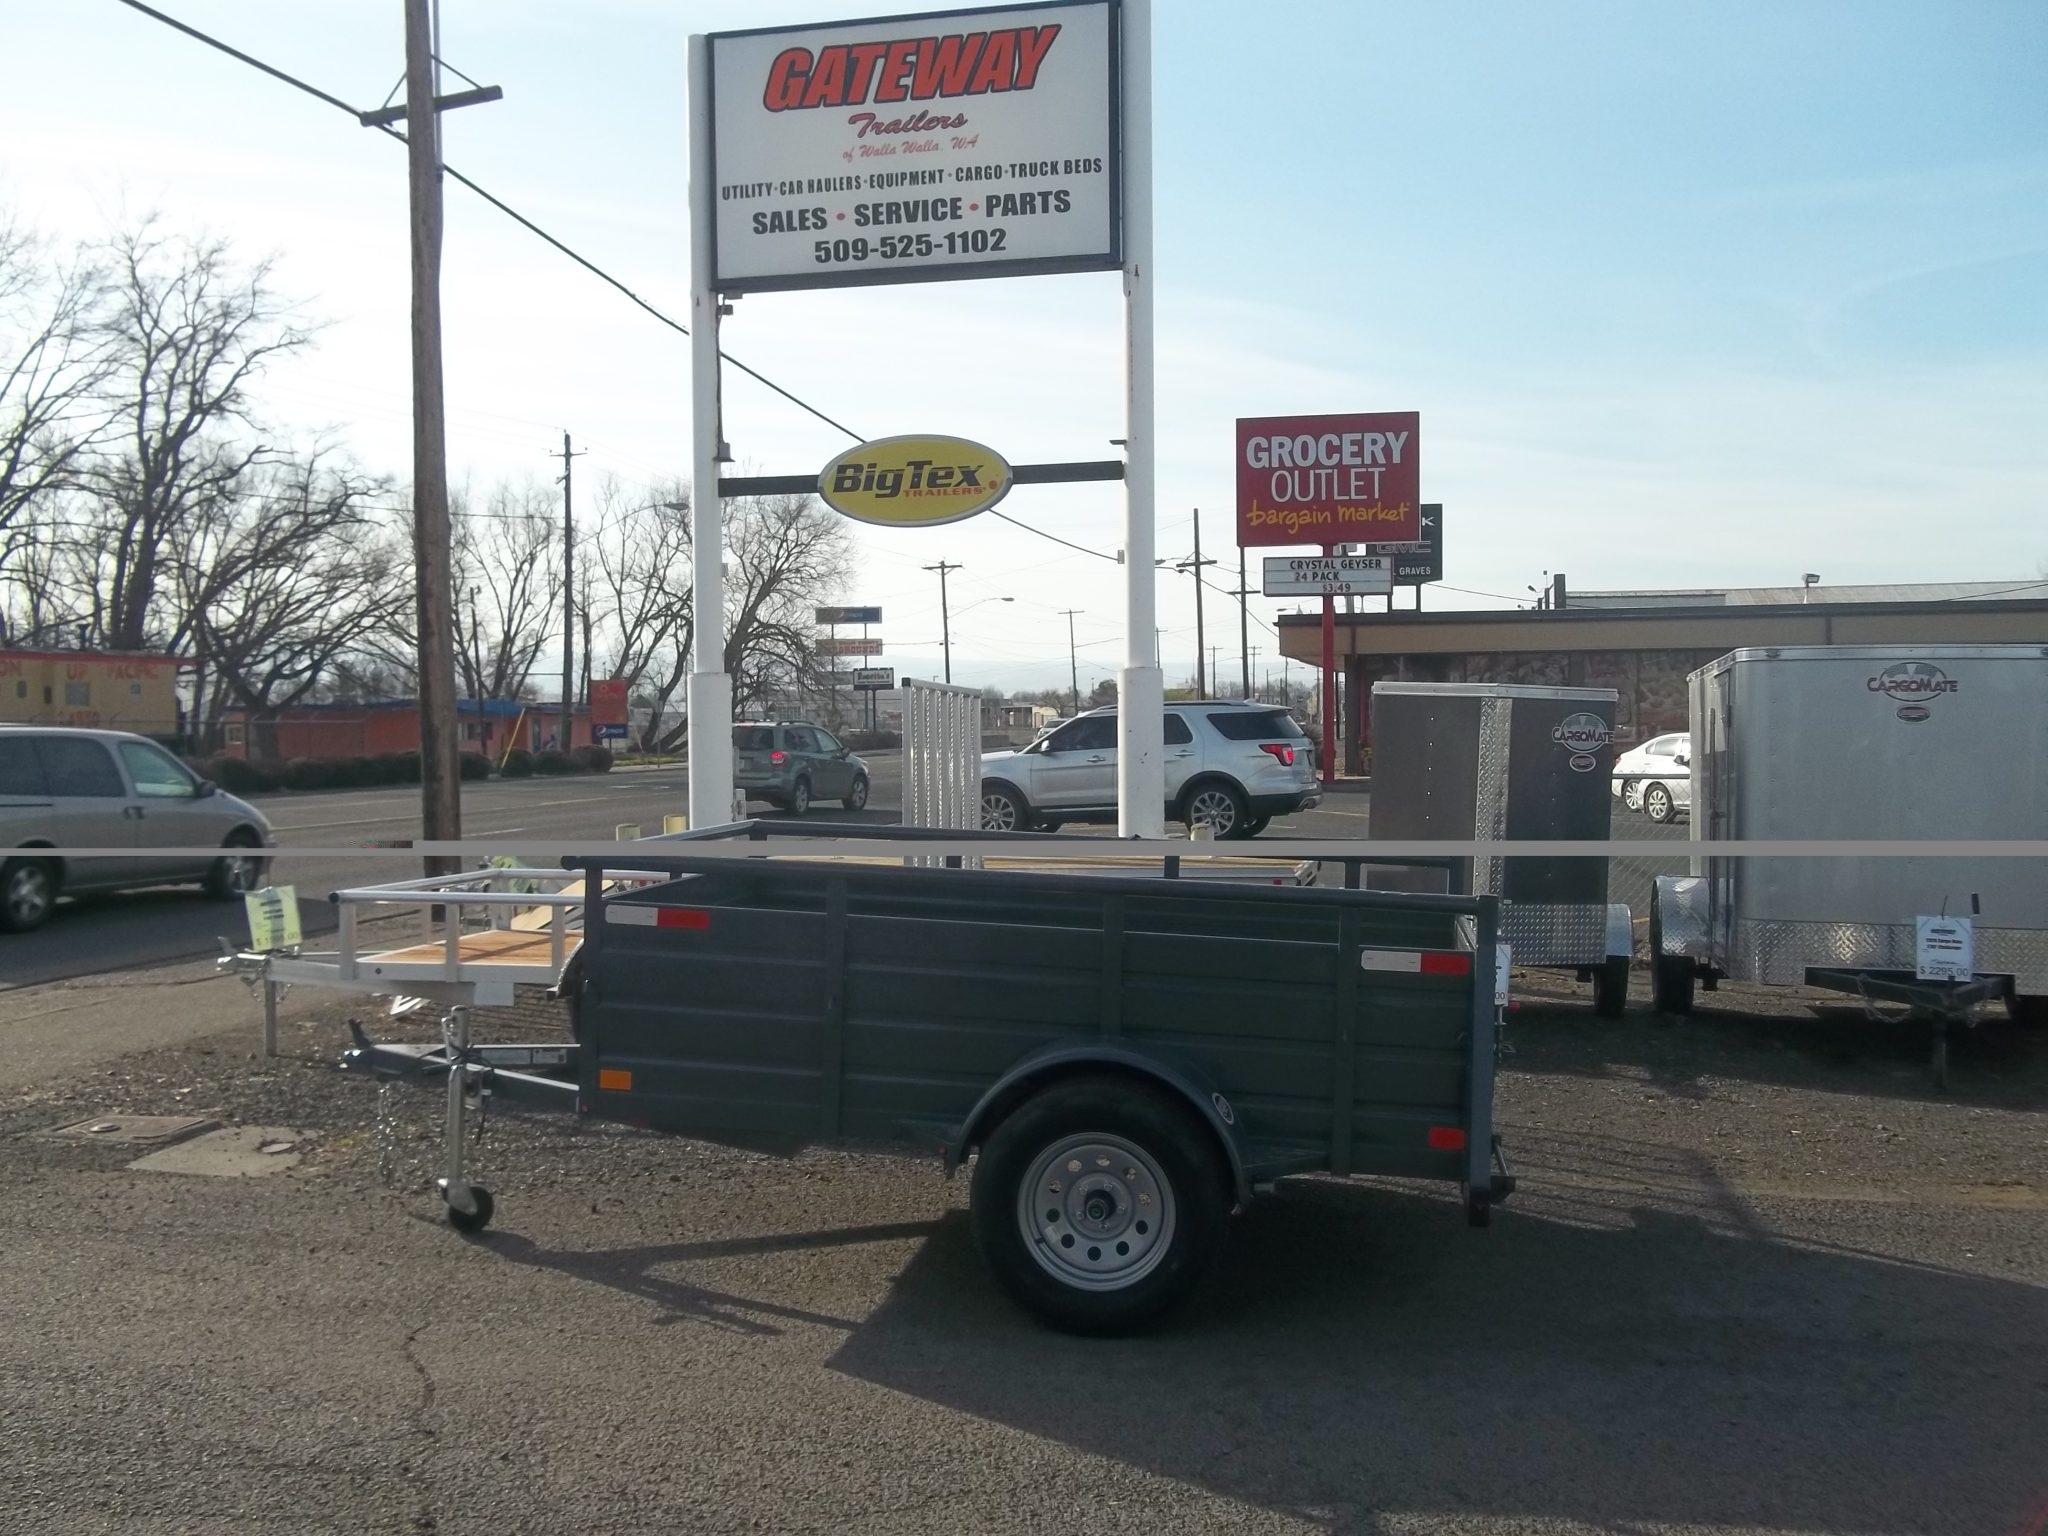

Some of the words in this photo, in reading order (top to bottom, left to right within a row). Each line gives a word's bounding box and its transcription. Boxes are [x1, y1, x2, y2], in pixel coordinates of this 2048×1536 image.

[763, 24, 1062, 112] GATEWAY
[848, 109, 968, 138] Trailers
[842, 147, 855, 163] of
[859, 143, 897, 157] Walla
[722, 182, 773, 200] UTILITY
[779, 180, 803, 196] CAR
[807, 175, 862, 193] HAULERS
[869, 169, 944, 189] EQUIPMENT
[955, 164, 1003, 182] CARGO
[1009, 161, 1060, 178] TRUCK
[1063, 158, 1103, 174] BEDS
[752, 207, 828, 234] SALES
[854, 197, 963, 227] SERVICE
[985, 189, 1071, 217] PARTS
[814, 228, 1006, 263] 509-525-1102
[1246, 431, 1408, 469] GROCERY
[903, 486, 984, 498] TRAILERS
[1271, 467, 1386, 503] OUTLET
[1246, 499, 1331, 535] bargain
[1338, 502, 1406, 523] market
[1290, 560, 1336, 570] CRYSTAL
[1341, 559, 1382, 569] GEYSER
[1295, 572, 1308, 581] 24
[1312, 571, 1340, 581] PACK
[1399, 567, 1431, 576] GRAVES
[1323, 583, 1351, 593] $3.49
